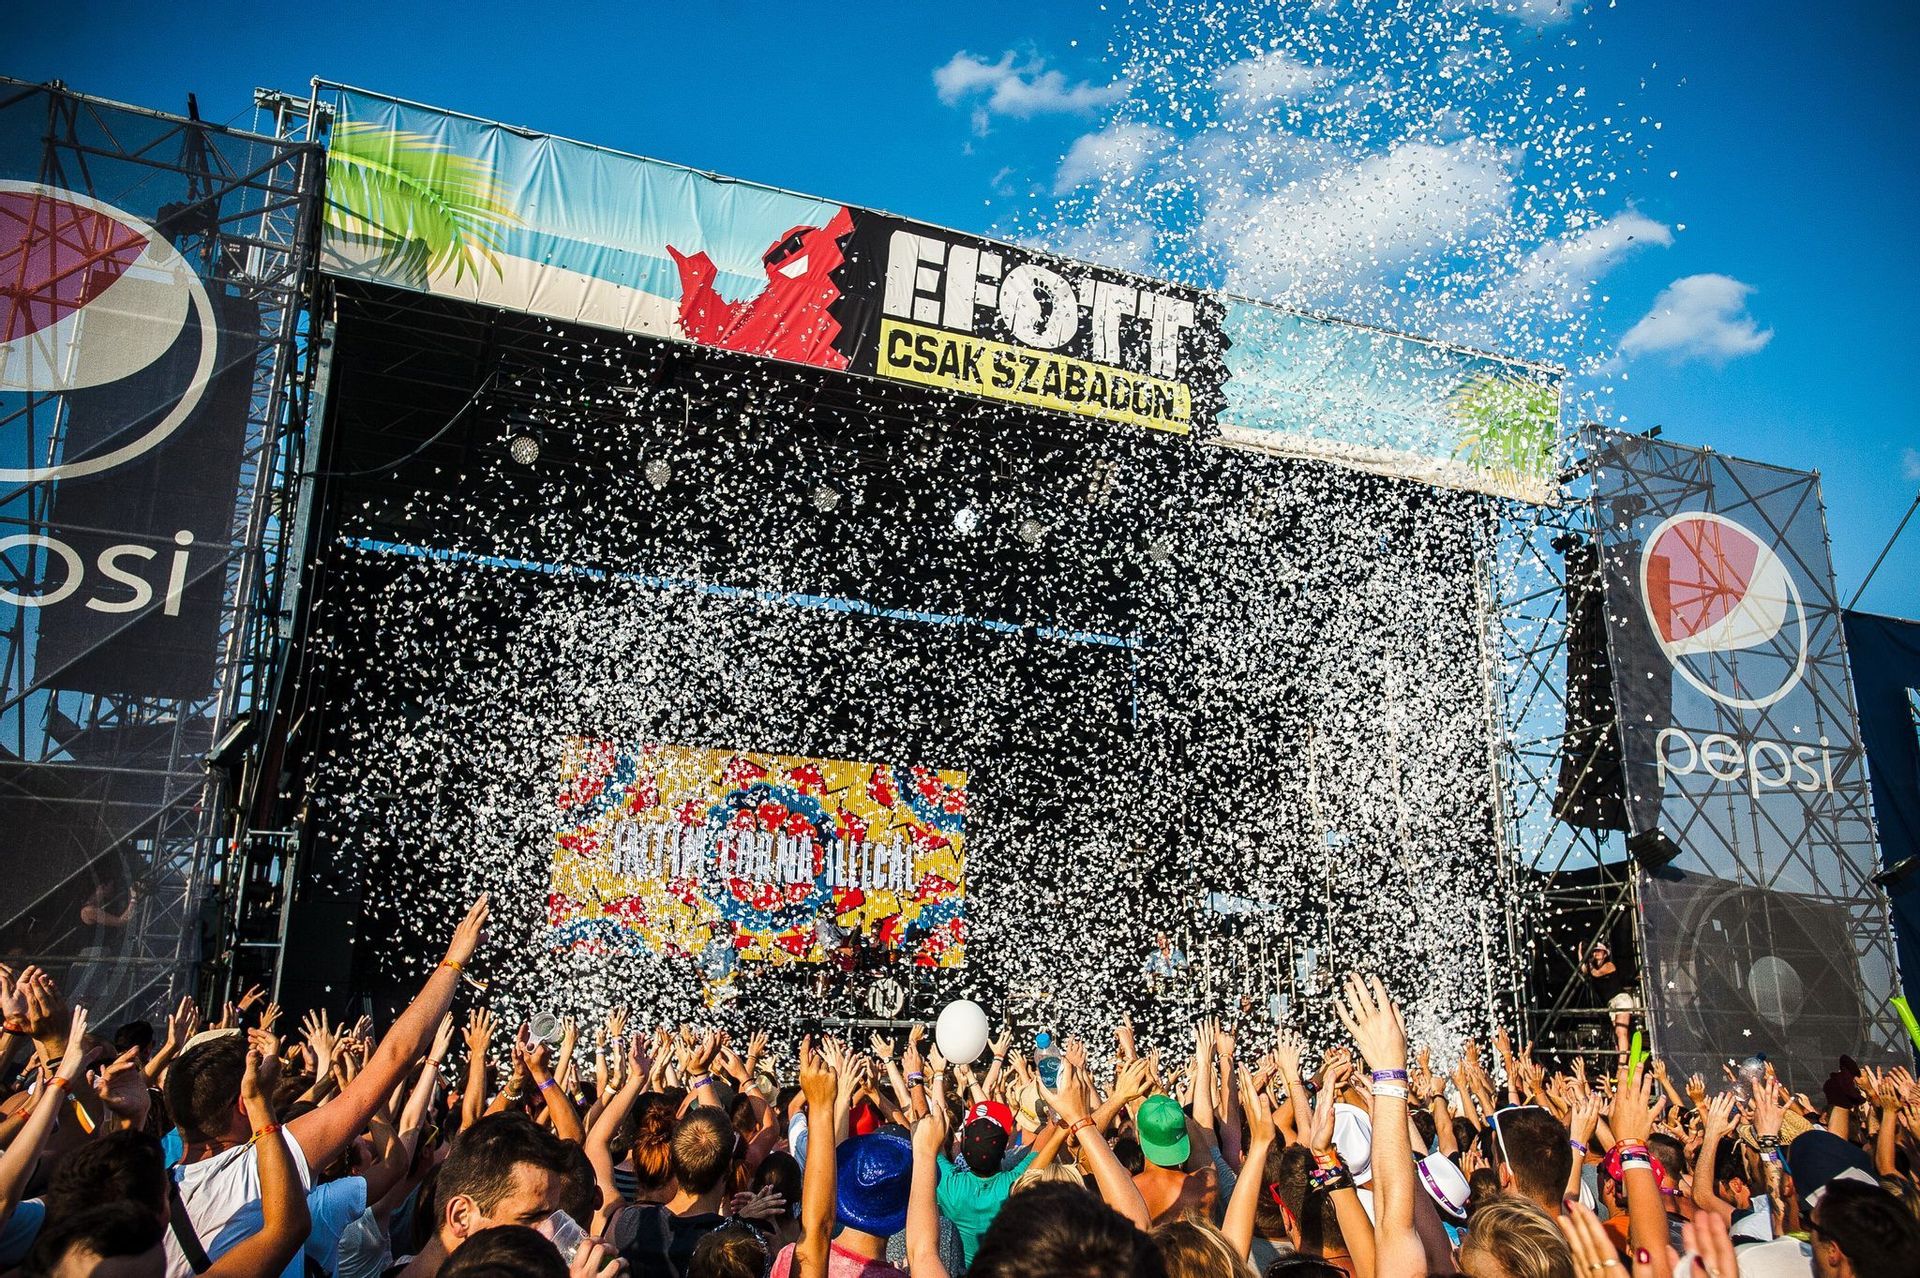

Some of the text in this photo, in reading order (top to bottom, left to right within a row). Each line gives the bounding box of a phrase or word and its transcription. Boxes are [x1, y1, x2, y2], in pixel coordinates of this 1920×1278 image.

[883, 230, 1195, 379] EFOTT
[887, 329, 985, 384] CSAK
[1655, 728, 1834, 799] pepsi
